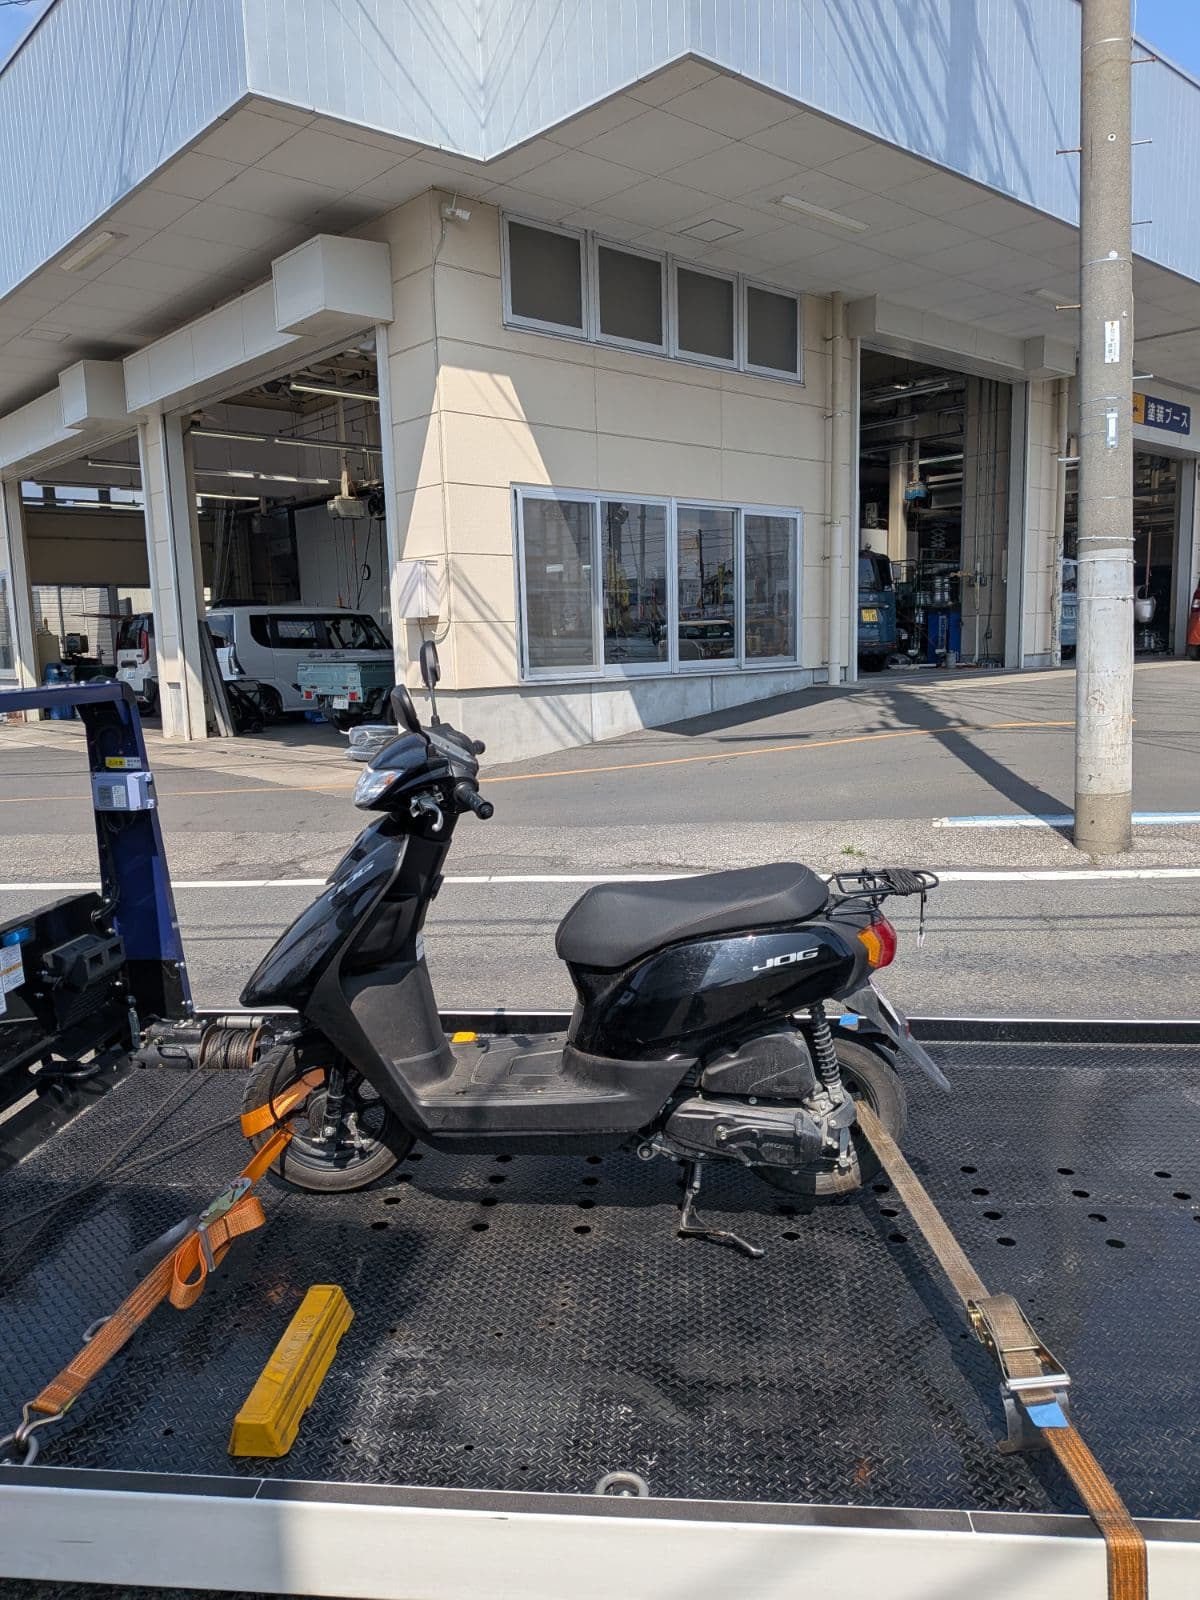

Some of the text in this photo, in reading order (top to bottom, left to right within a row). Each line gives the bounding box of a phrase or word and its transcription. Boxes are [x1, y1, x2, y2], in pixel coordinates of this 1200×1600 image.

[1147, 402, 1188, 428] 塗装ブース
[752, 947, 819, 971] JOG
